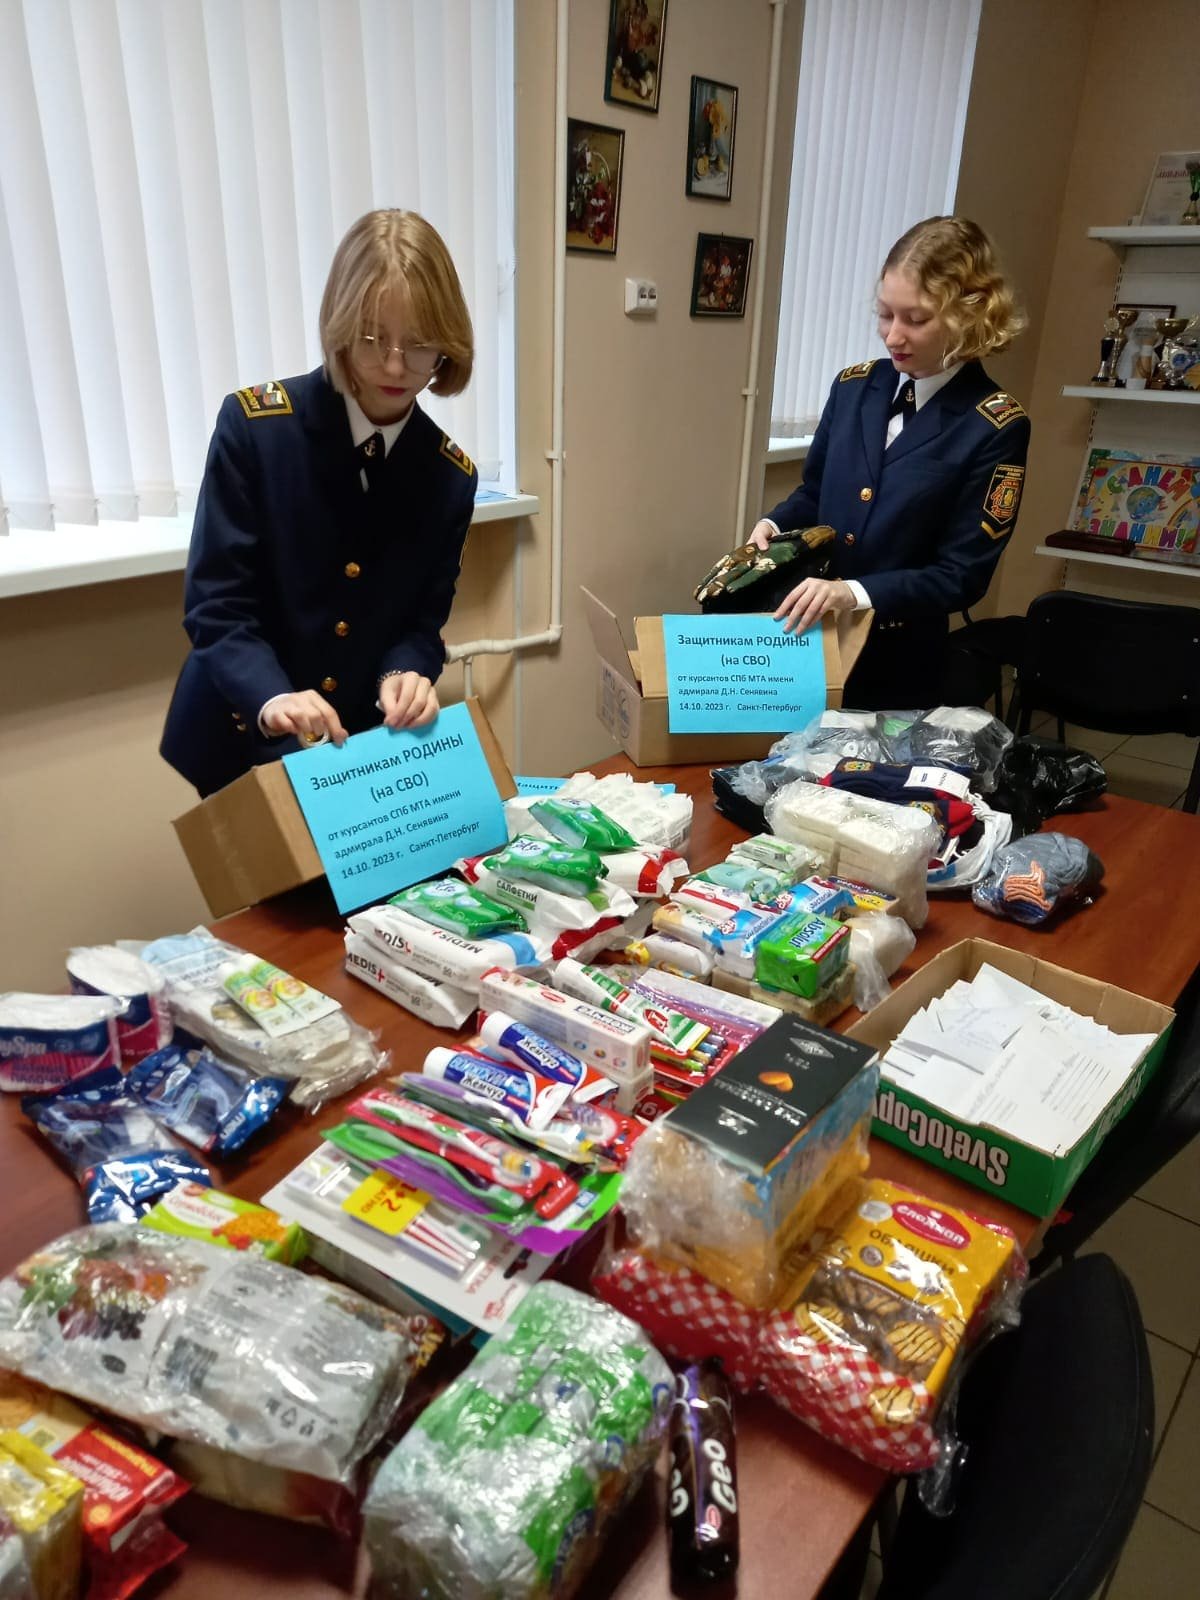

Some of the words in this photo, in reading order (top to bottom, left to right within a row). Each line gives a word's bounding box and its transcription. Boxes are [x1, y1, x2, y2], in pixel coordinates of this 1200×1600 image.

[677, 634, 754, 647] Защитникам
[756, 636, 810, 648] РОДИНЫ
[721, 654, 740, 667] (на
[742, 654, 771, 667] СВО)
[688, 675, 729, 684] курсантов
[748, 675, 767, 683] МТА
[721, 688, 738, 696] Д.Н.
[740, 688, 778, 696] Сенявина
[679, 703, 702, 711] 14.10.
[705, 703, 724, 711] 2023
[737, 703, 803, 712] Санкт-Петербург
[310, 755, 402, 791] Защитникам
[404, 733, 464, 763] РОДИНЫ
[371, 785, 394, 803] (на
[396, 771, 429, 793] СВО)
[328, 831, 340, 842] от
[341, 815, 389, 840] курсантов
[390, 806, 409, 820] СПб
[410, 799, 431, 814] МТА
[432, 789, 462, 806] имени
[335, 837, 384, 860] адмирала
[385, 828, 405, 845] Д.Н.
[406, 812, 449, 834] Сенявина
[341, 862, 371, 879] 14.10.
[372, 853, 395, 868] 2023
[396, 852, 404, 860] г.
[409, 821, 480, 853] Санкт-Петербург
[496, 879, 538, 903] САЛФЕТКИ
[789, 917, 826, 949] Absolut
[461, 1075, 506, 1102] Жемчуг
